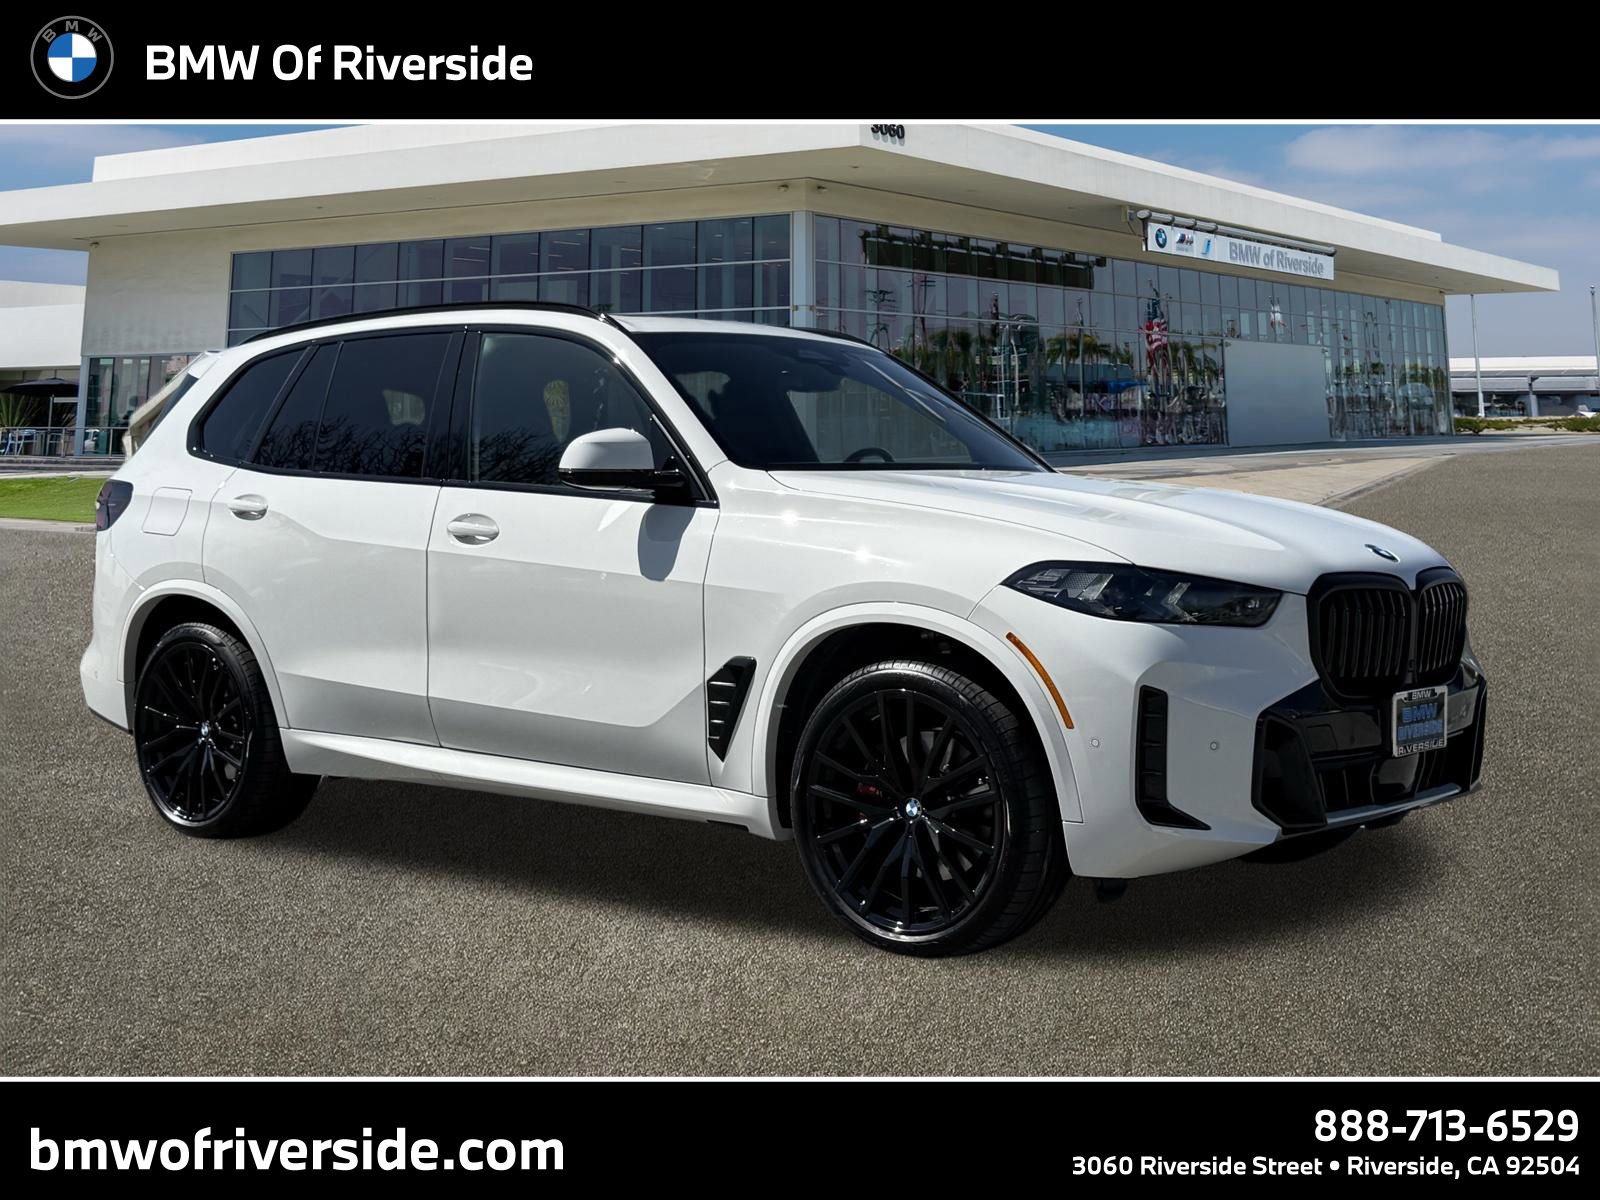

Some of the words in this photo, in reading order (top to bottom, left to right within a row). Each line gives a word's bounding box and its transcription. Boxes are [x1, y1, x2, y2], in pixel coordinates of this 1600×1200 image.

[1229, 241, 1261, 265] BMW
[1263, 249, 1275, 268] of
[1276, 250, 1324, 275] Riverside
